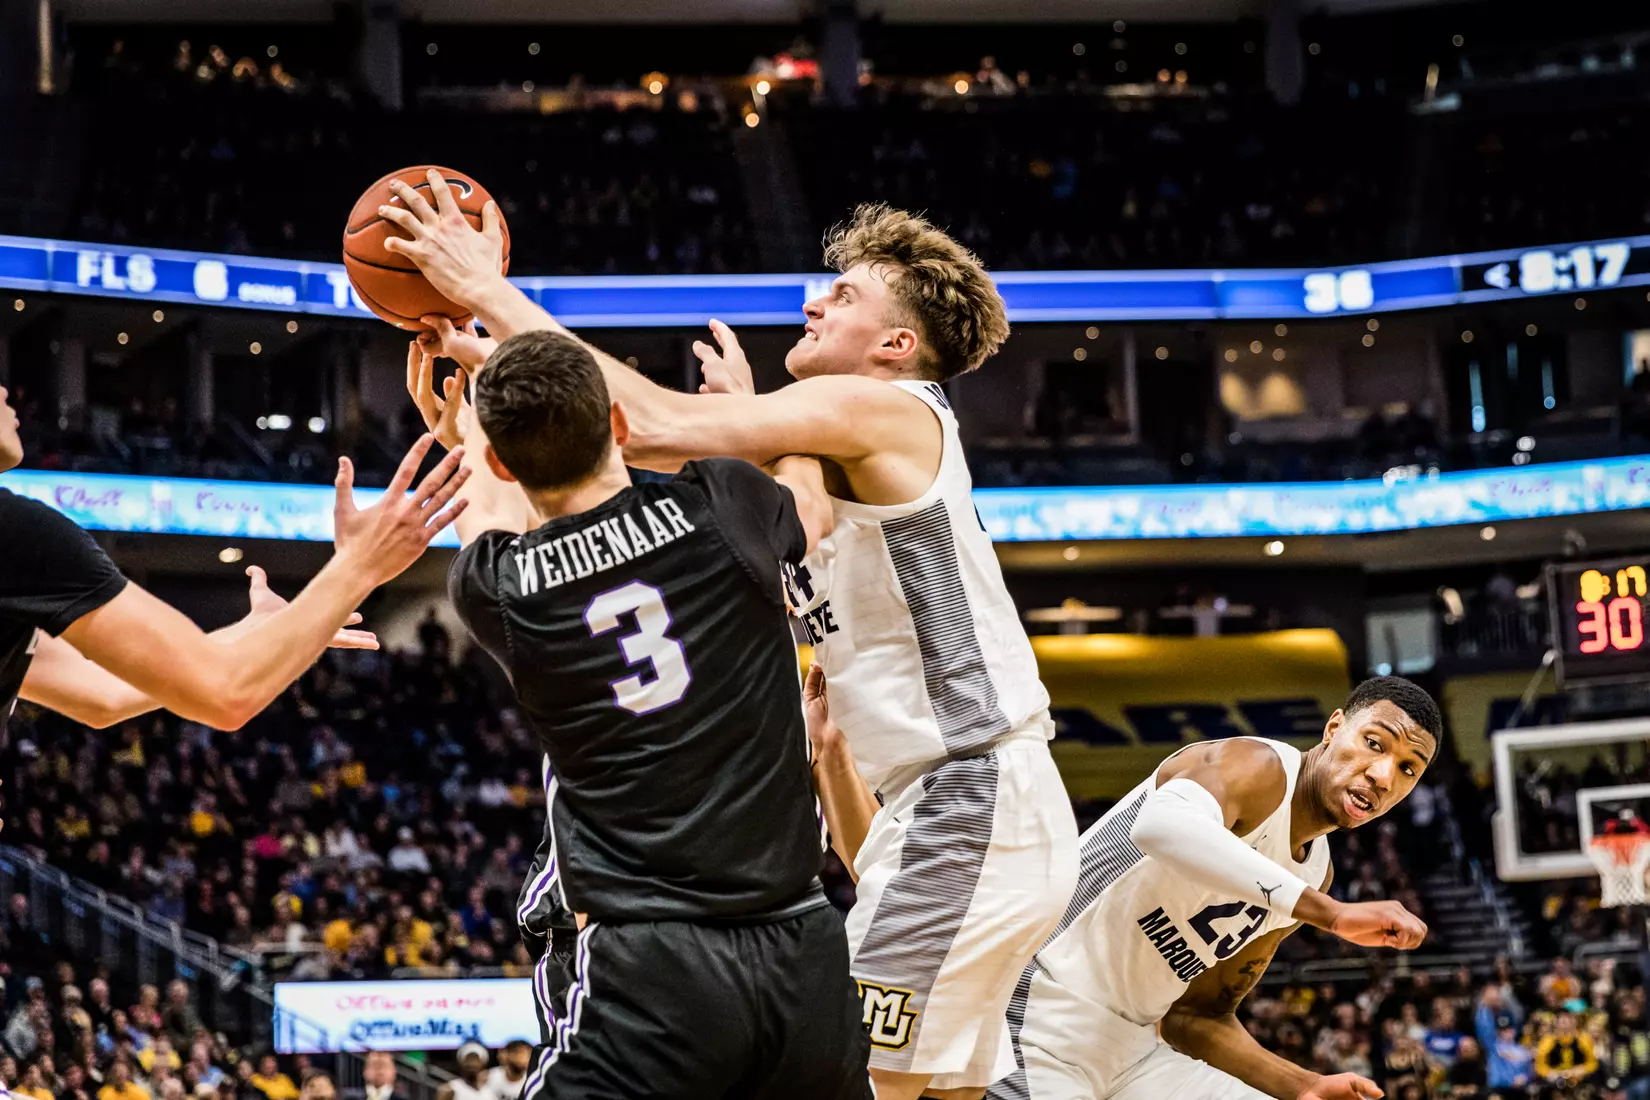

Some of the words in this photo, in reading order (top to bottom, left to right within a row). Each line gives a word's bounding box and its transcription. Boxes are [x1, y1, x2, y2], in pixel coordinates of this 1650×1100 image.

[77, 250, 157, 293] FLS
[1519, 241, 1630, 293] 8:17
[514, 497, 696, 597] WEIDENAAR
[582, 578, 694, 718] 3
[1575, 596, 1645, 654] 30
[856, 979, 921, 1053] MU
